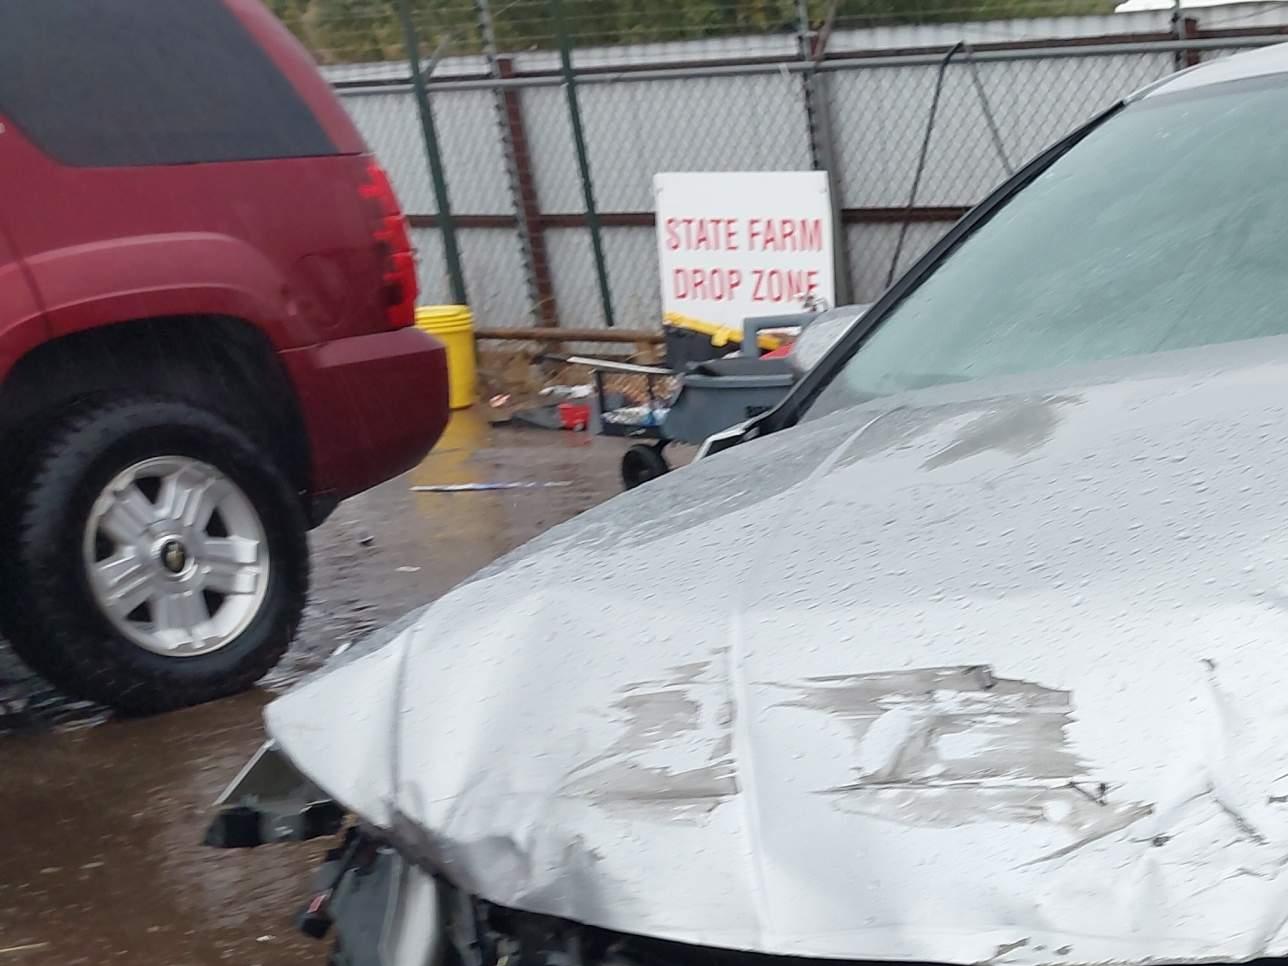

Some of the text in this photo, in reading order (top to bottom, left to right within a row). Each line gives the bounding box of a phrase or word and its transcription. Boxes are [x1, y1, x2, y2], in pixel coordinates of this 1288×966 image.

[665, 217, 823, 252] STATE FARM
[672, 267, 821, 303] DROP ZONE
